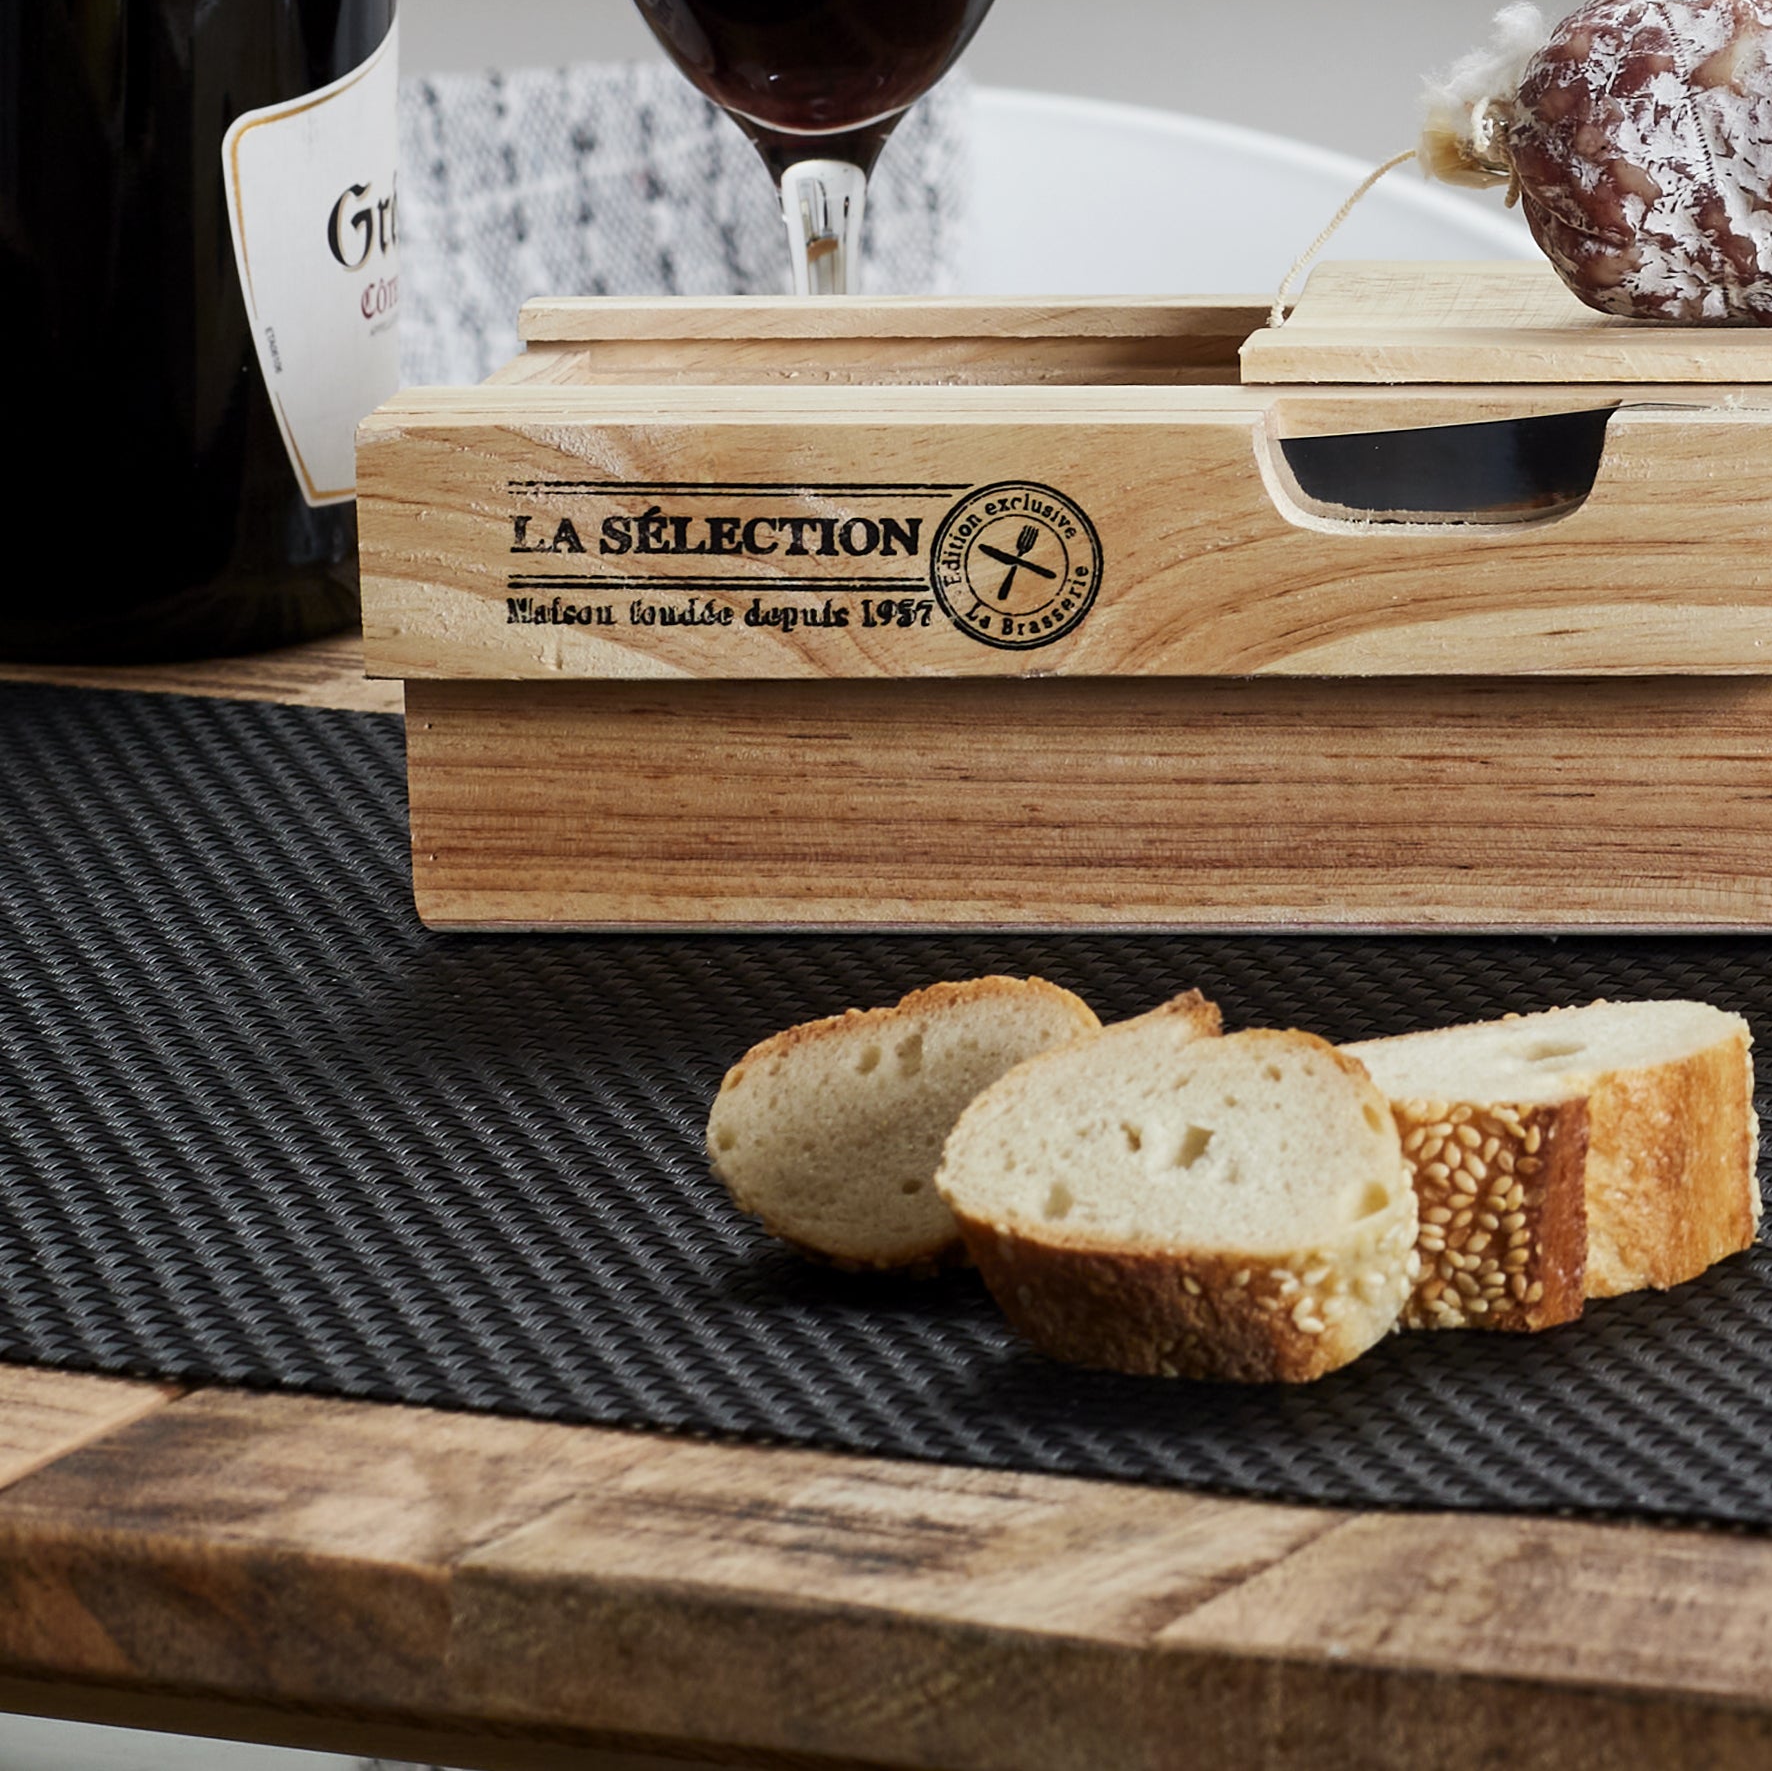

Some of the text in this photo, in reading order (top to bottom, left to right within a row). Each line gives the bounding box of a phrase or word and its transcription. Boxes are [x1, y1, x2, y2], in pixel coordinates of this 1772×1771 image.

[510, 506, 926, 557] LA SÉLECTION
[985, 493, 1077, 539] exclusive
[506, 597, 616, 626] Maison
[744, 598, 850, 633] depuis
[965, 565, 1089, 636] La Brasserie
